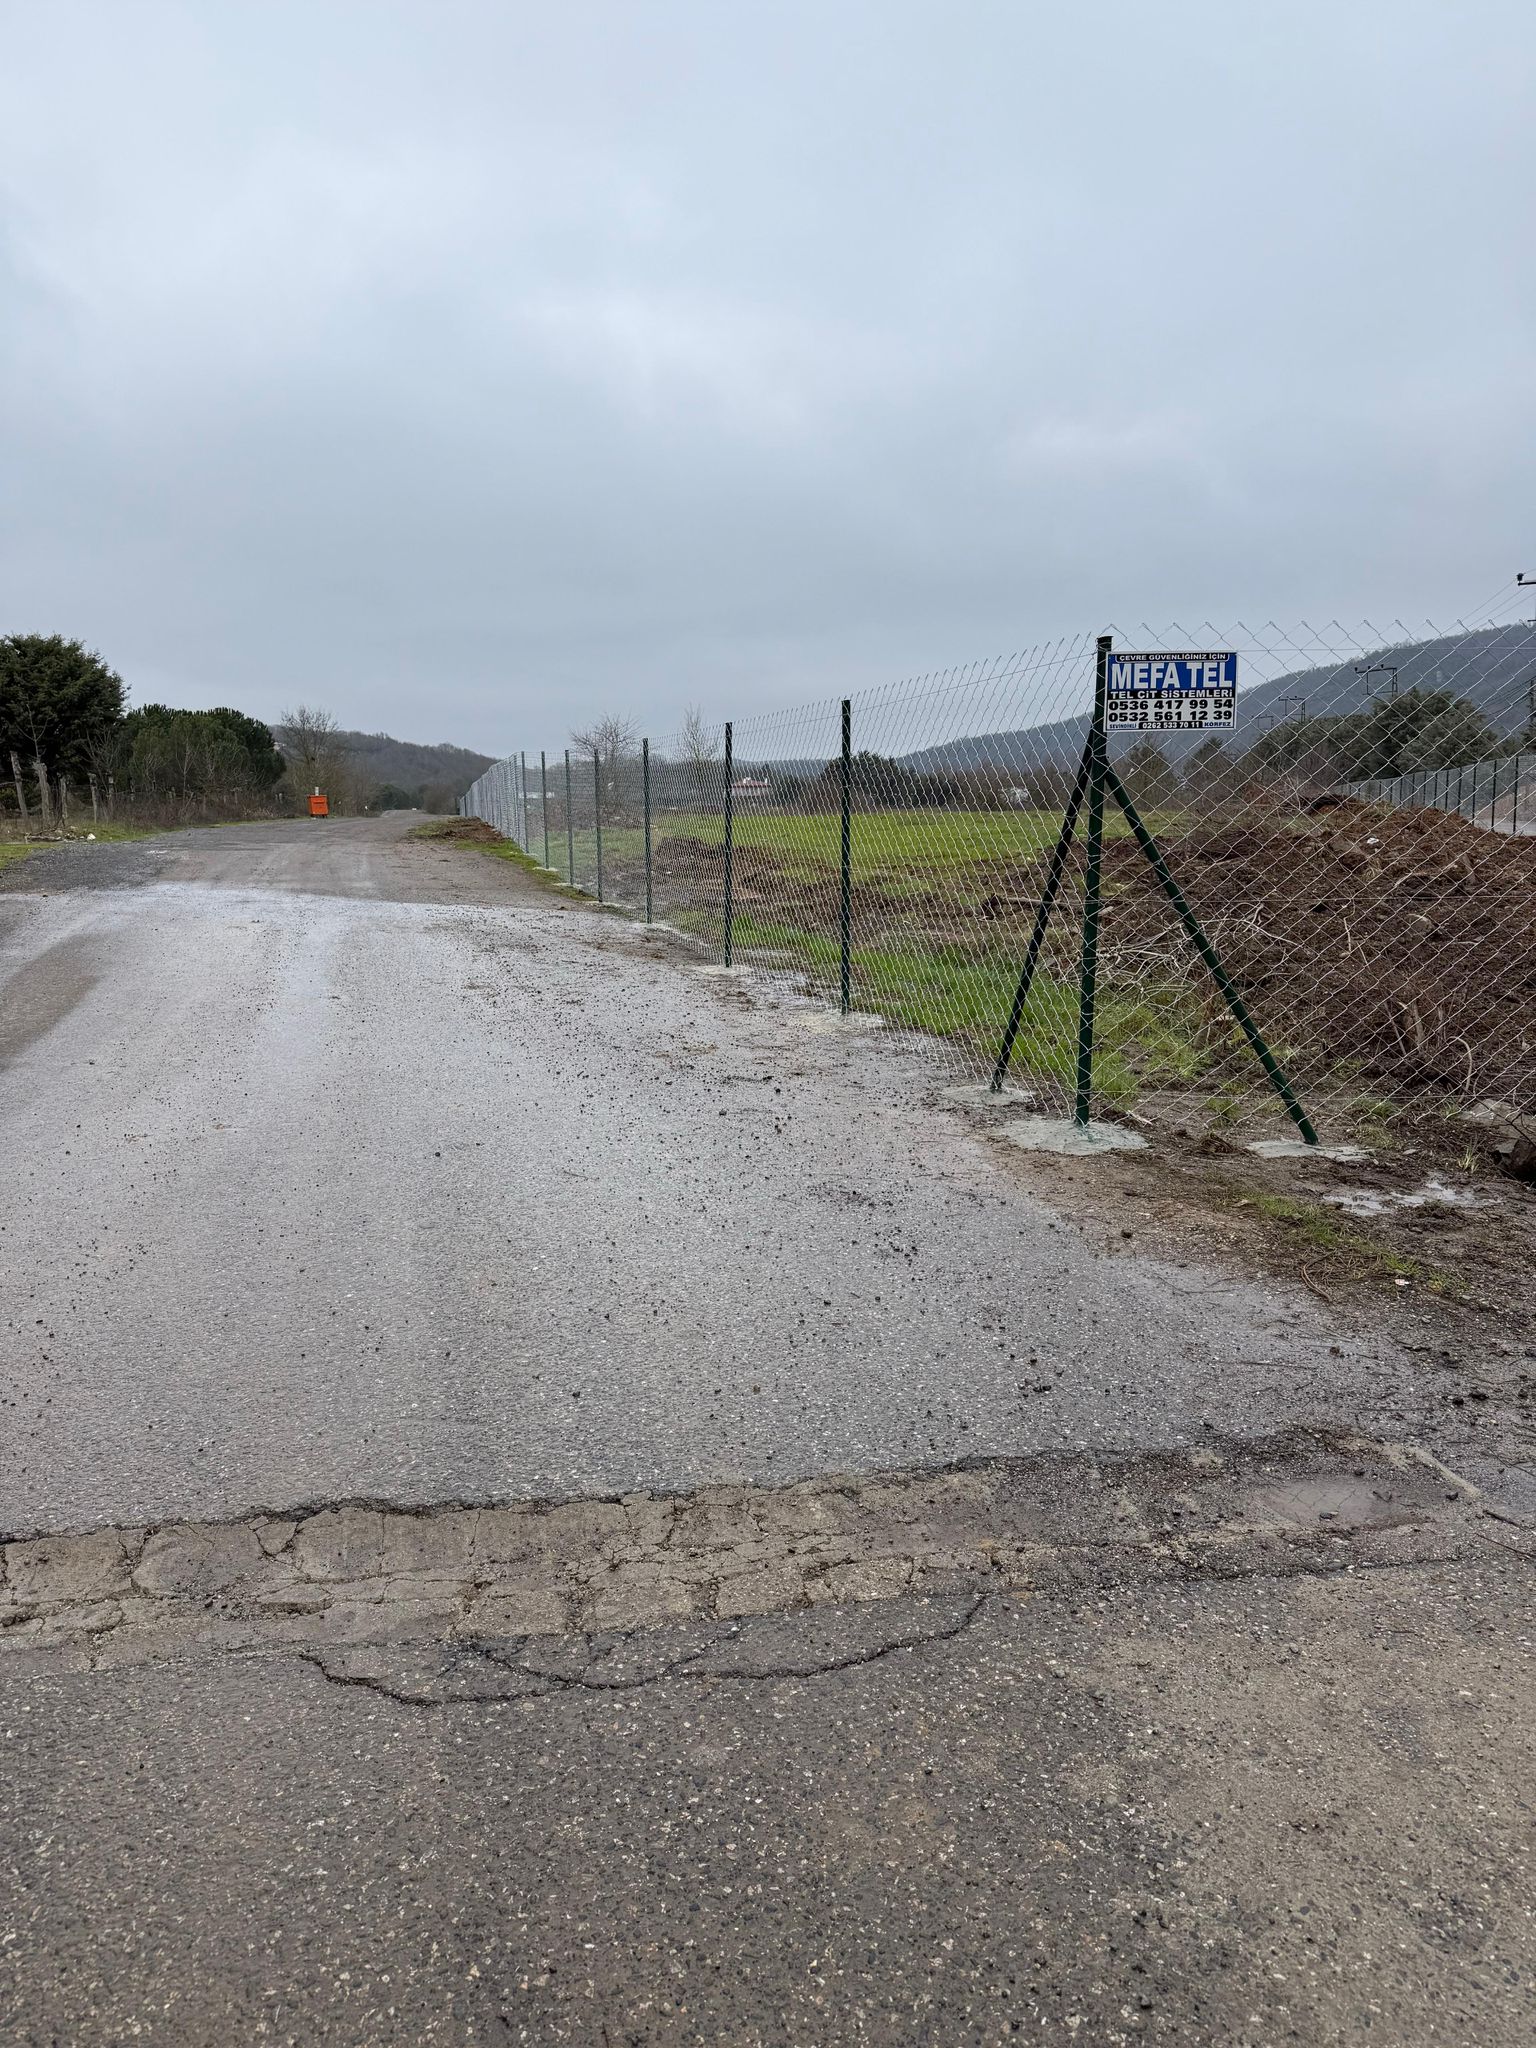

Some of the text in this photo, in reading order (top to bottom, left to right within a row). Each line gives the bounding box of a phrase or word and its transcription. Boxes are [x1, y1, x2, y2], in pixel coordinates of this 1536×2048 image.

[1112, 662, 1232, 689] MEFA TEL
[1109, 699, 1233, 710] 0536 417 99 54
[1109, 710, 1232, 722] 0532 561 12 39
